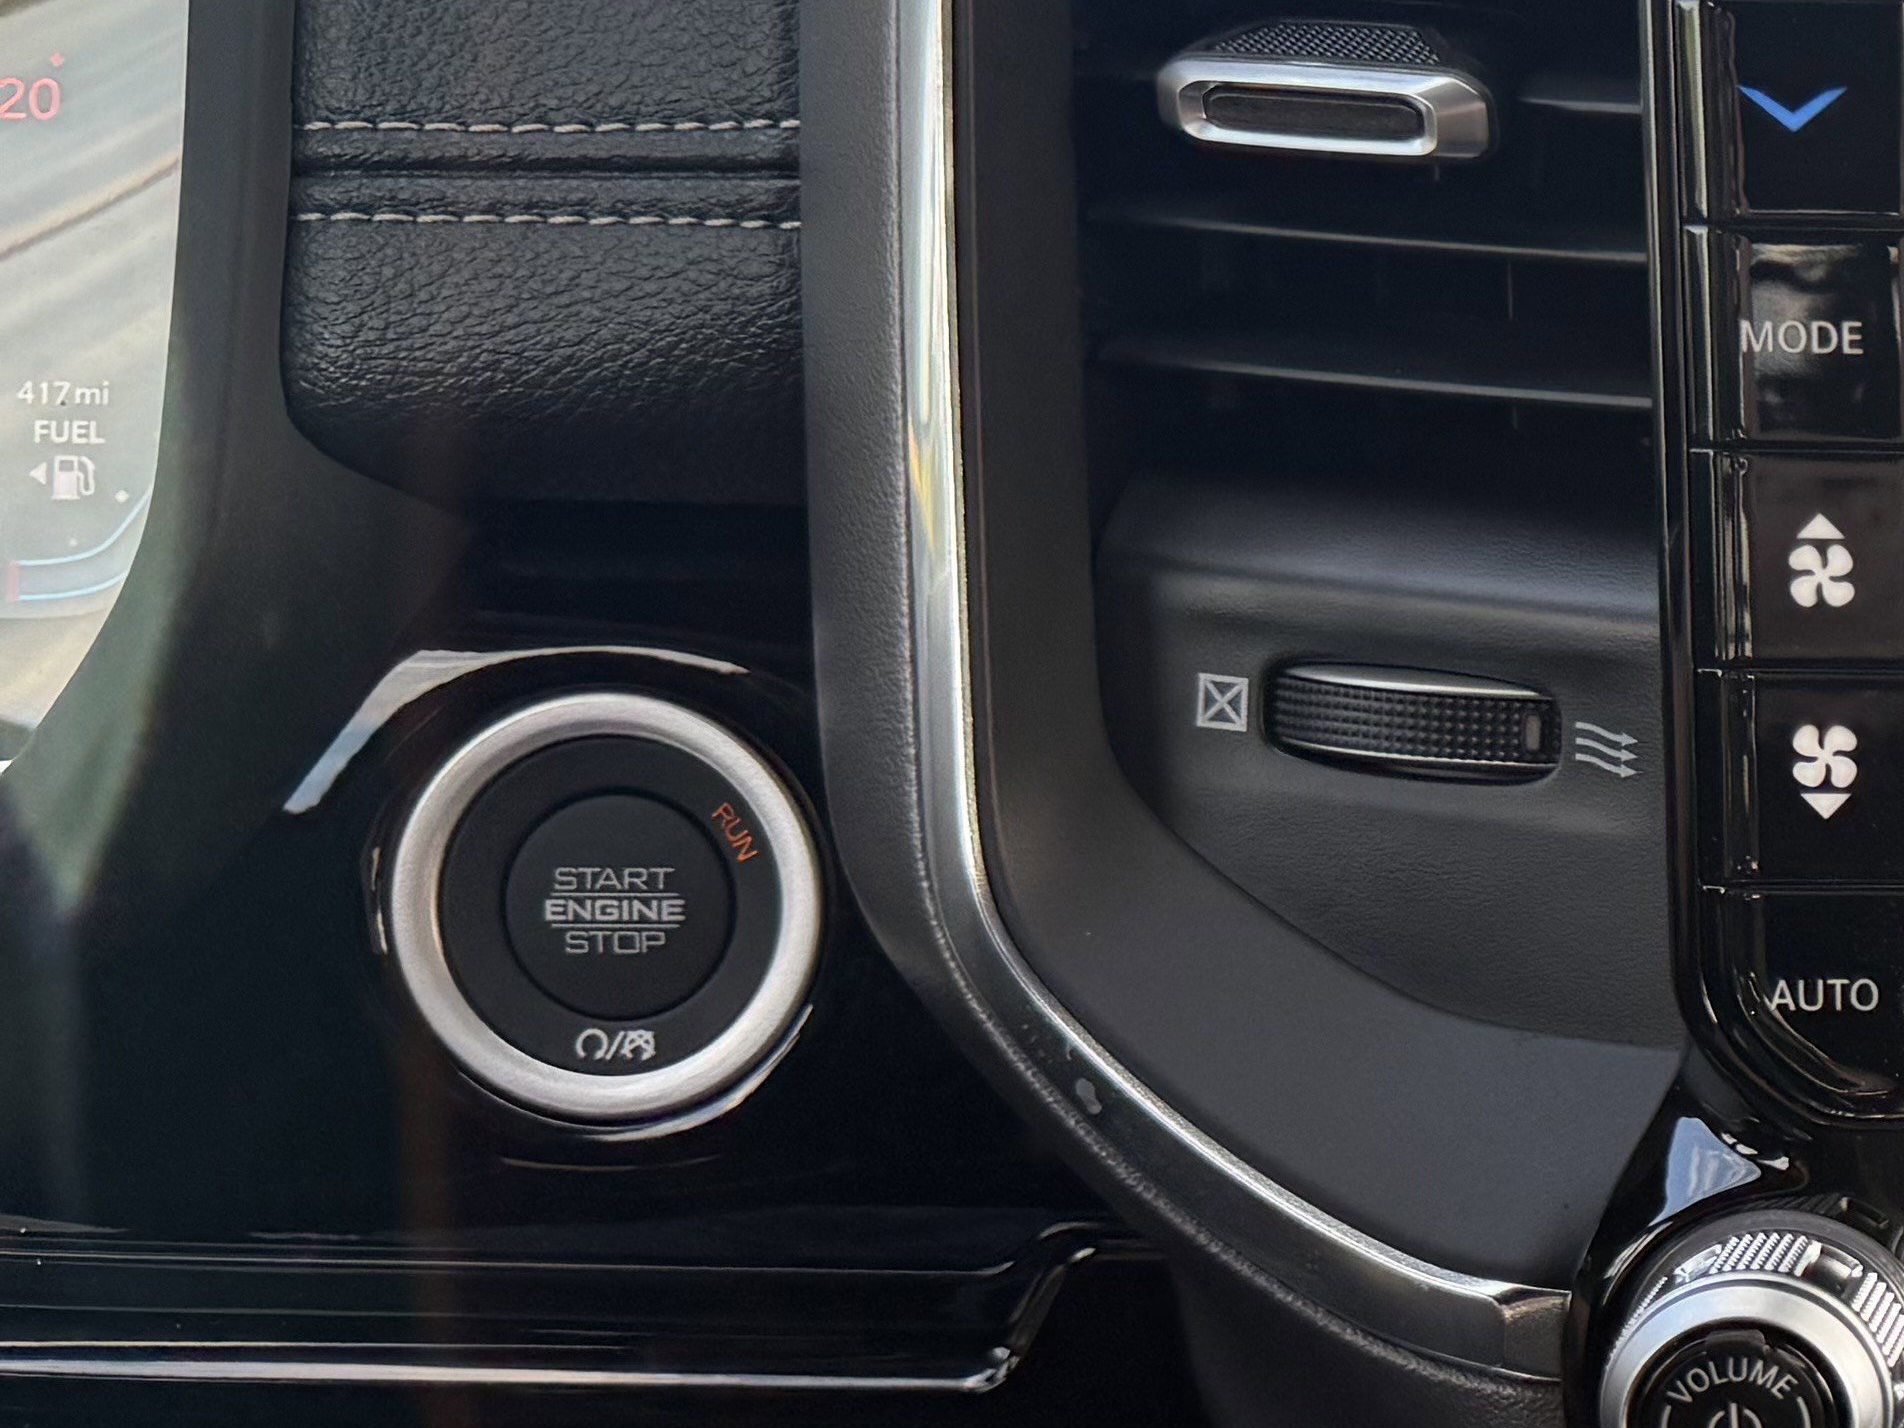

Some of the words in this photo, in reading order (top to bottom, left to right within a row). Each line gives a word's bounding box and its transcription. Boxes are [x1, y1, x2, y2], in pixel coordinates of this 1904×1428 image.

[1740, 320, 1864, 356] MODE
[33, 420, 106, 445] FUEL
[711, 803, 759, 863] RUN
[554, 867, 676, 891] START
[545, 899, 687, 922] ENGINE
[565, 930, 666, 954] STOP
[1769, 978, 1880, 1013] AUTO
[1667, 1357, 1799, 1405] VOLUME
